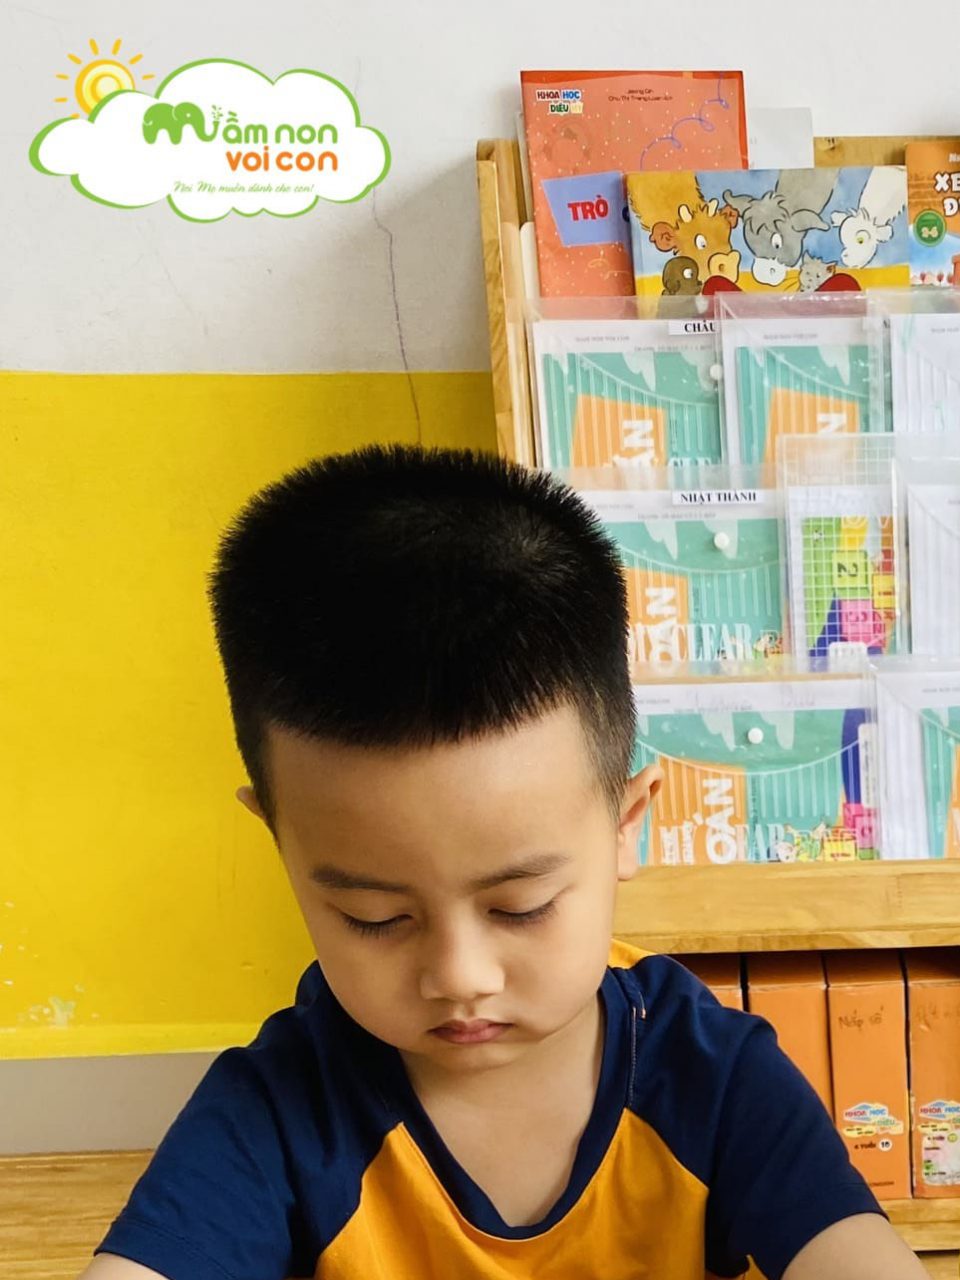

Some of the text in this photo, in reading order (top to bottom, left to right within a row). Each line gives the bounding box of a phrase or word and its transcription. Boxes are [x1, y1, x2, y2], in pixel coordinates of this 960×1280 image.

[537, 91, 560, 99] KHOA
[568, 195, 609, 221] TRÒ
[693, 778, 737, 865] OÁN
